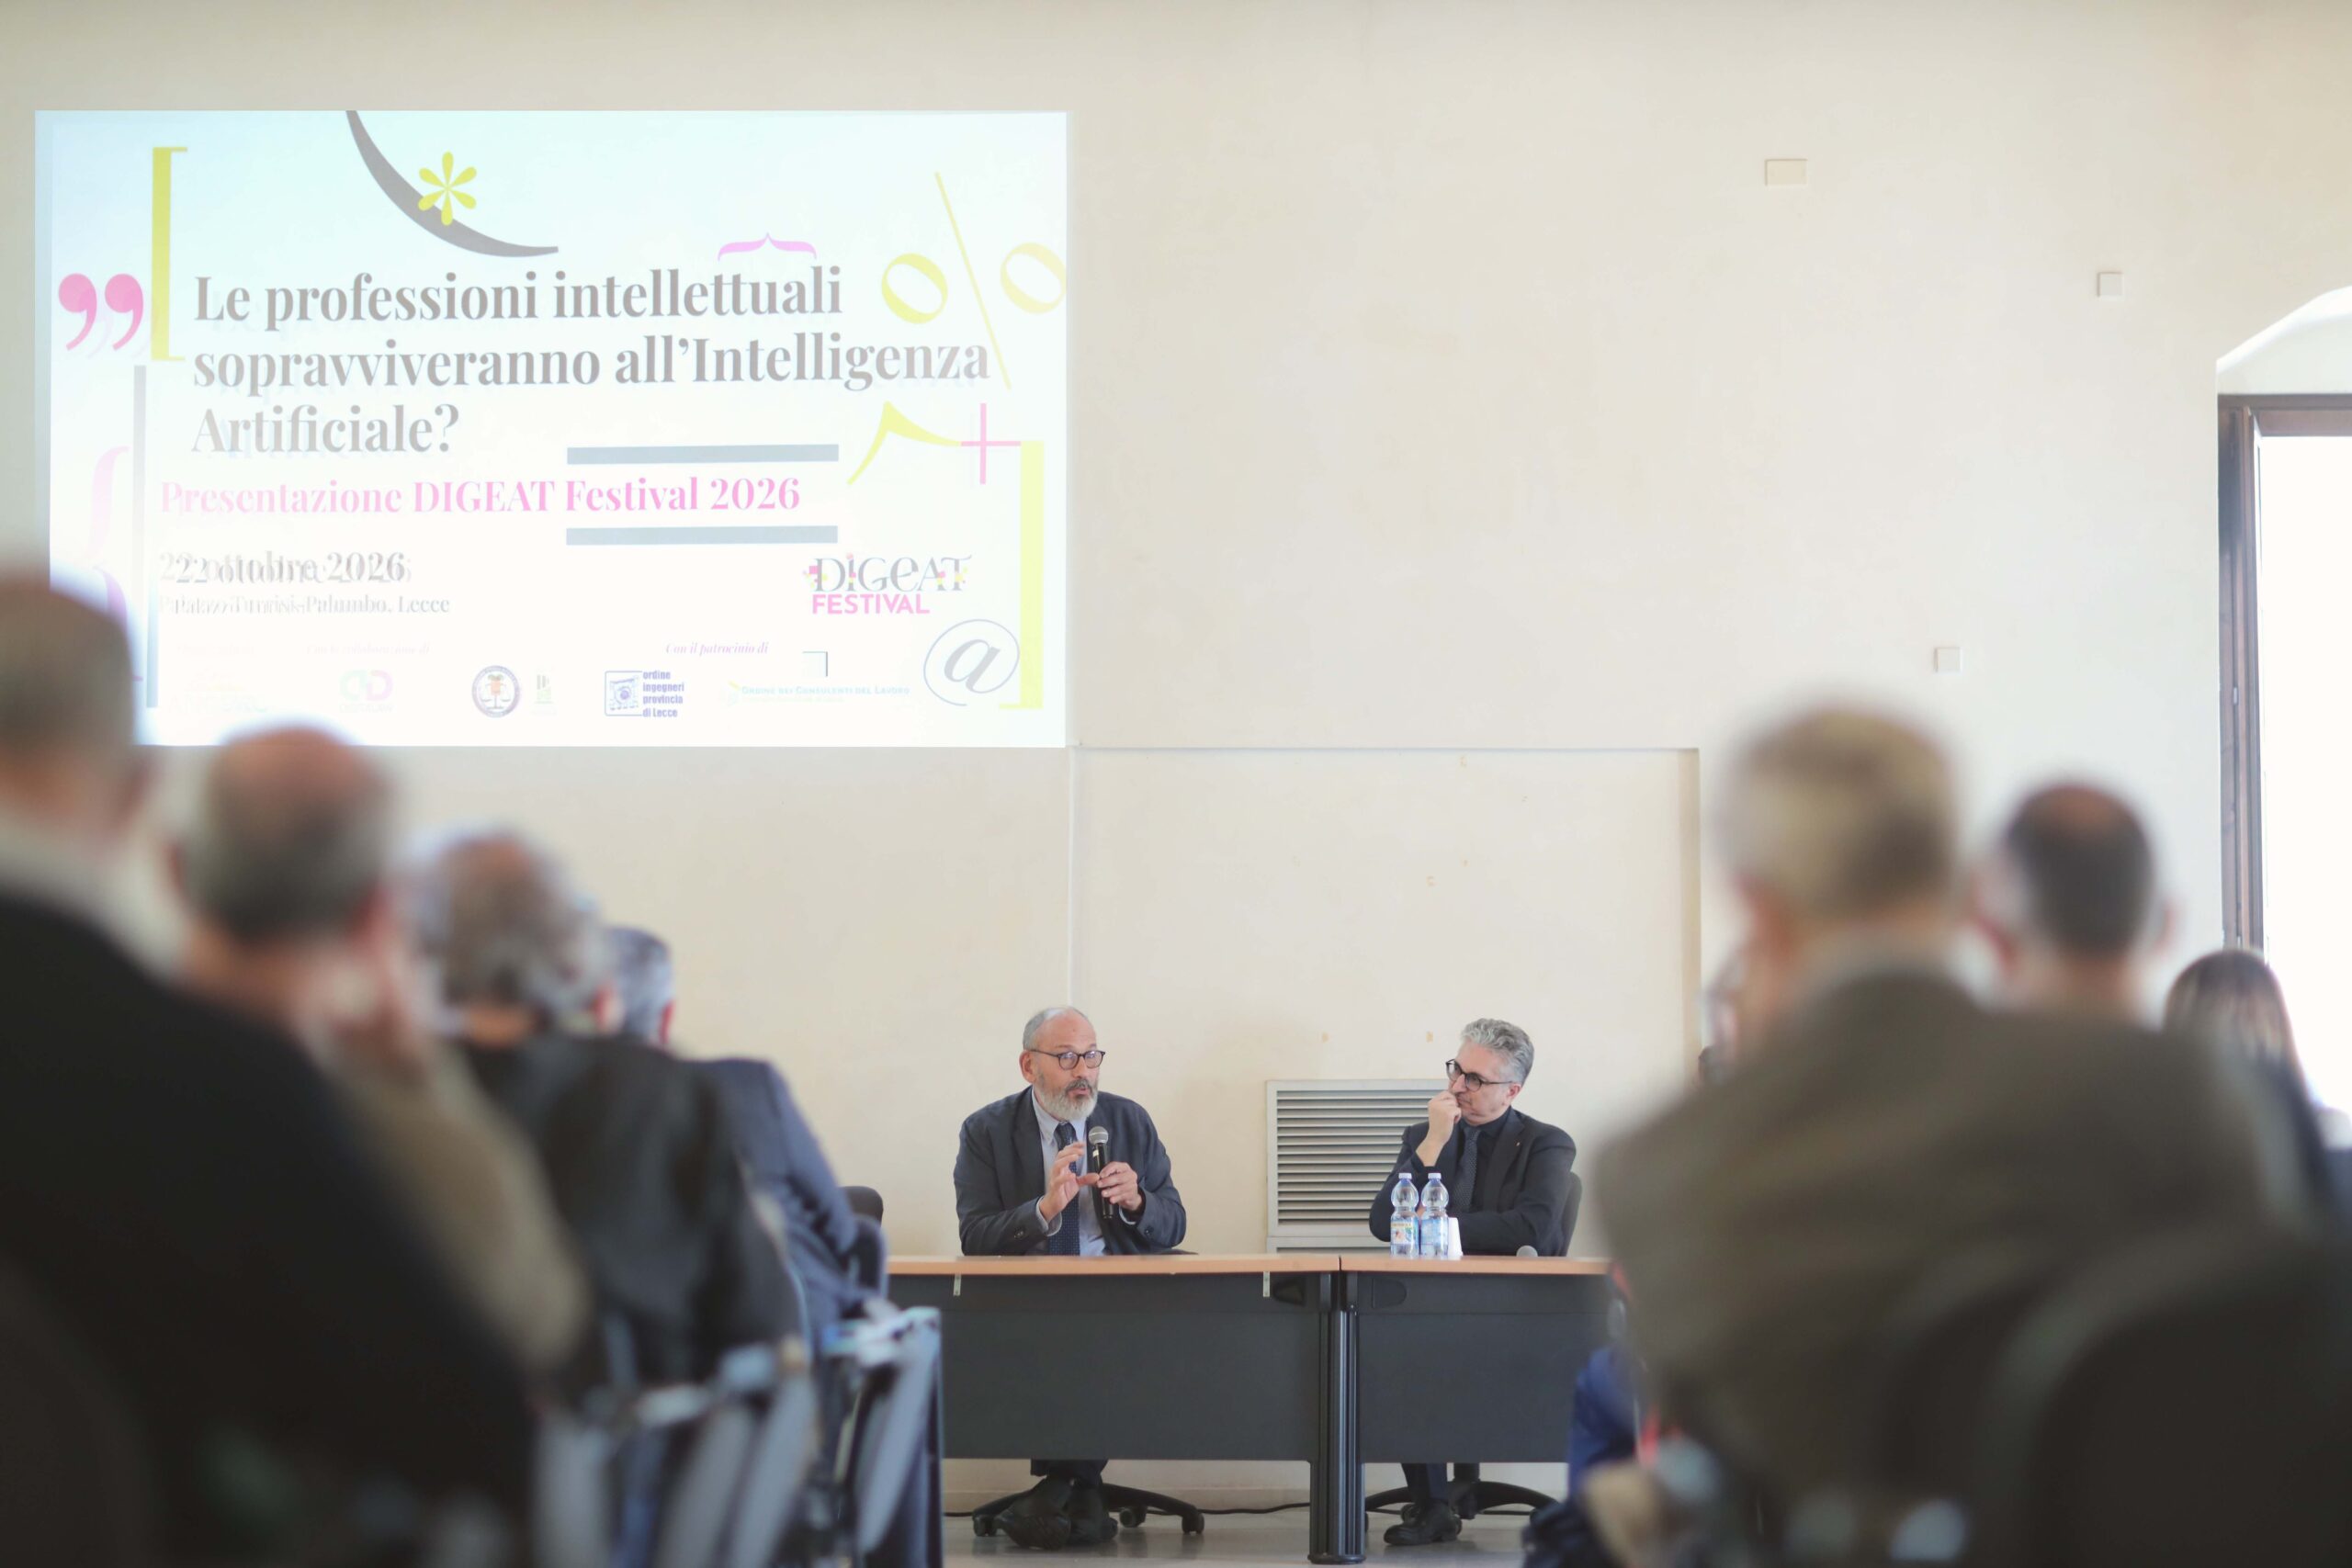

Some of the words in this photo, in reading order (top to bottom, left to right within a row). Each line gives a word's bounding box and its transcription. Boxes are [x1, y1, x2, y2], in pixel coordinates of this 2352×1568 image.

[194, 275, 250, 321] Le
[265, 271, 538, 332] professioni
[553, 265, 844, 318] intellettuali
[193, 338, 601, 397] sopravviveranno
[190, 404, 458, 454] Artificiale?
[161, 479, 401, 514] Presentazione
[413, 479, 555, 513] DIGEAT
[565, 476, 698, 512] Festival
[709, 478, 800, 511] 2026
[326, 551, 411, 583] 2026
[397, 594, 450, 615] Lecce
[812, 593, 931, 615] FESTIVAL
[642, 671, 672, 681] ordine
[642, 682, 685, 694] ingegneri
[642, 694, 684, 705] provincia
[642, 707, 651, 717] di
[652, 707, 679, 718] Lecce
